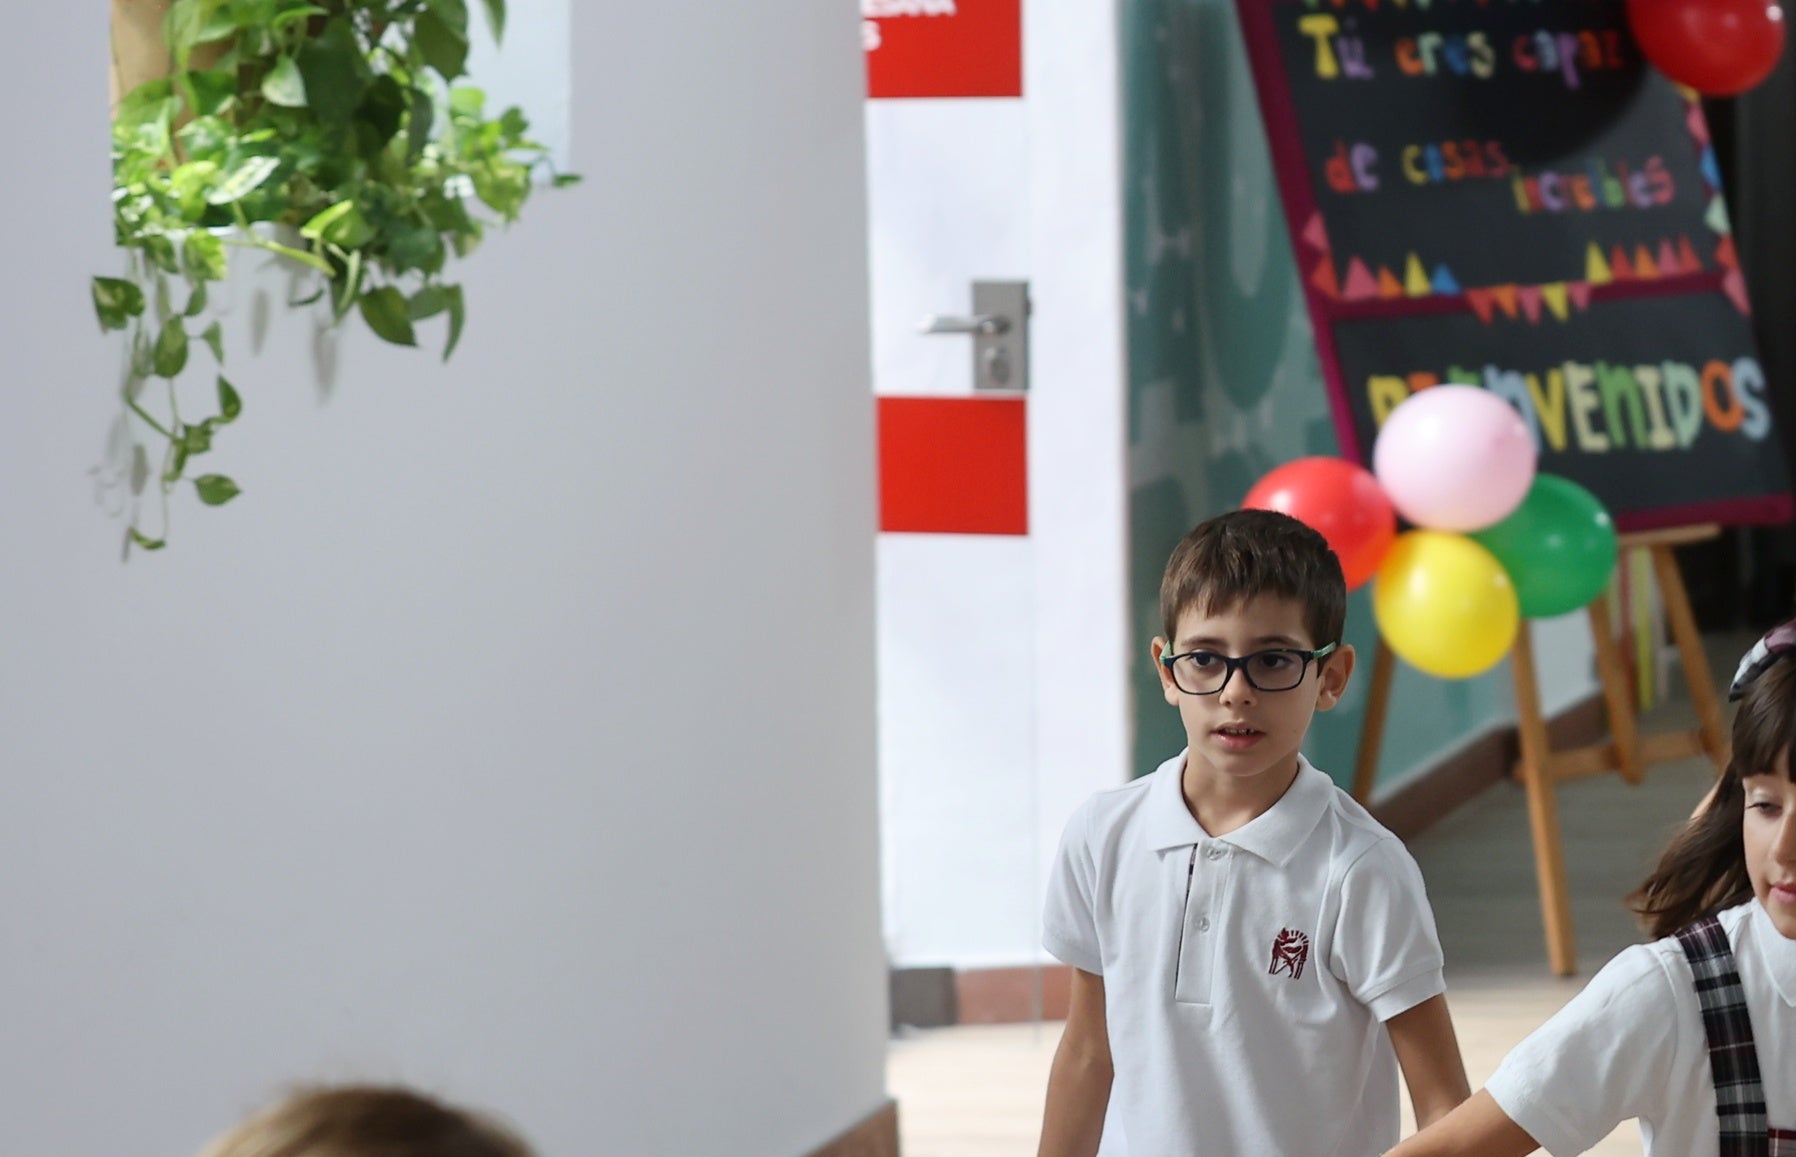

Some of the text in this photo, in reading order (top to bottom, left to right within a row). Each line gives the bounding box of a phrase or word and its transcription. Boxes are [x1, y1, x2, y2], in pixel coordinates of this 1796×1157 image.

[1395, 31, 1496, 79] eres
[1325, 138, 1379, 193] de
[1402, 139, 1509, 185] cosas
[1366, 356, 1772, 454] NVENIDOS
